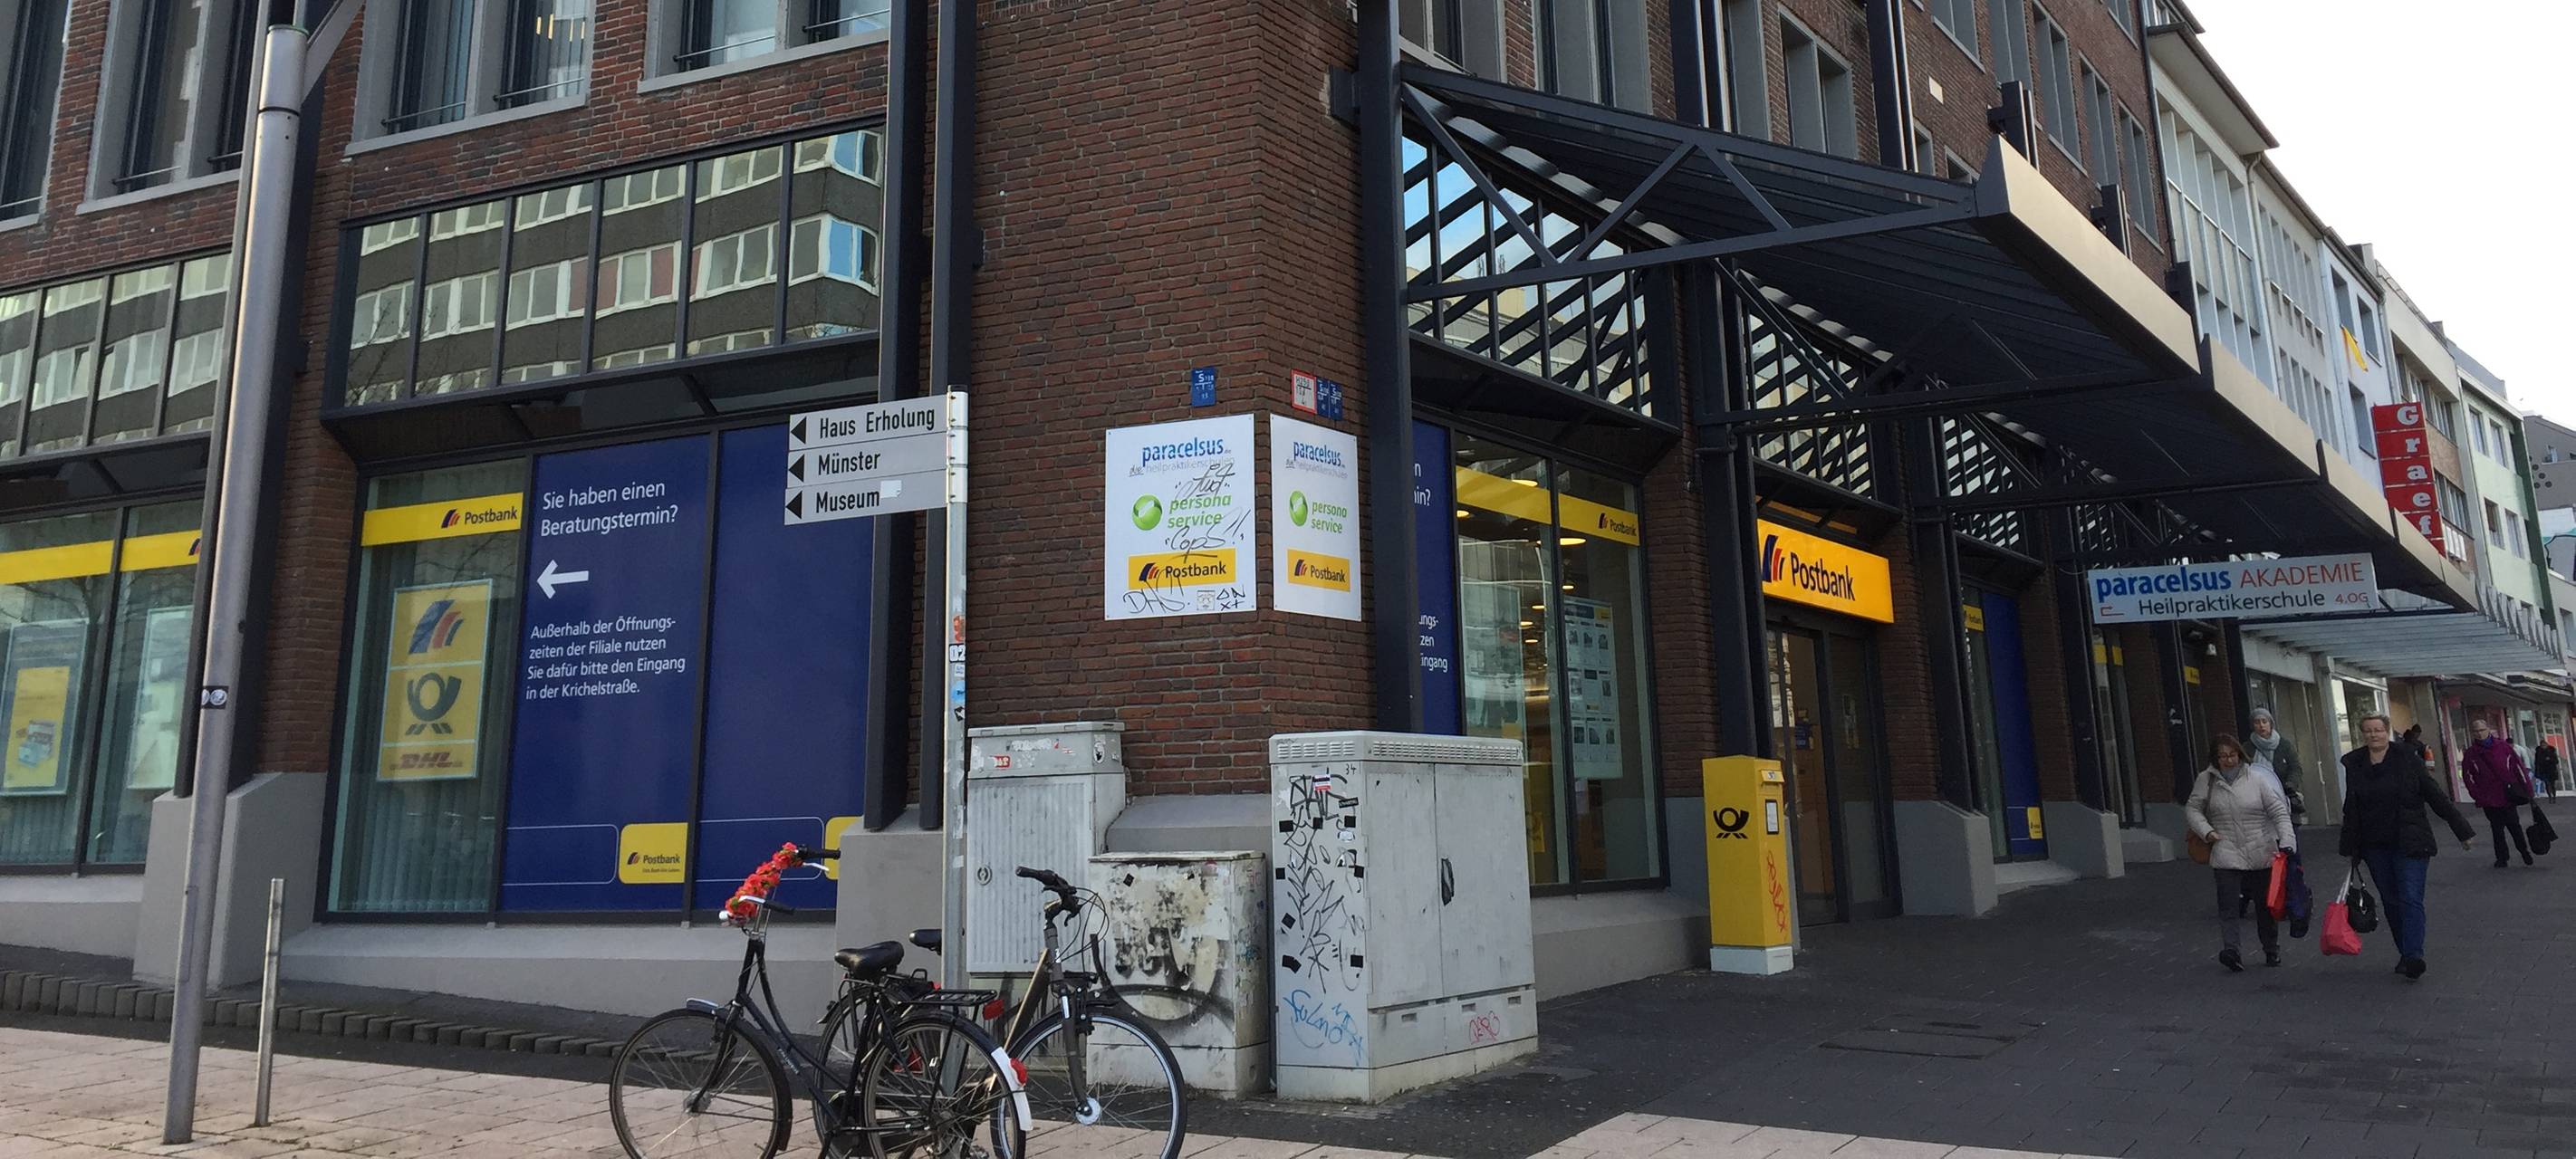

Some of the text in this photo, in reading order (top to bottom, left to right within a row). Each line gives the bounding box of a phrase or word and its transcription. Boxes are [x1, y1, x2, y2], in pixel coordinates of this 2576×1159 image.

[820, 407, 936, 439] Haus Erholung
[818, 451, 881, 476] Münster
[1142, 437, 1225, 468] paracelsus
[1293, 441, 1341, 467] paracelsus
[2397, 406, 2432, 535] Graef
[543, 481, 666, 510] Sie haben einen
[816, 491, 879, 513] Museum
[1169, 494, 1232, 514] persona
[464, 505, 518, 525] Postbank
[540, 504, 679, 537] Beratungstermin?
[1168, 511, 1223, 528] service
[1312, 518, 1342, 533] service
[1165, 560, 1227, 579] Postbank
[1310, 565, 1346, 583] Postbank
[1790, 551, 1855, 601] Postbank
[2096, 562, 2365, 603] paracelsus AKADEMIE
[2139, 589, 2325, 618] Heilpraktikerschule
[530, 616, 677, 639] Außerhalb der Öffnungs-
[529, 638, 666, 659] zeiten der Filiale nutzen
[527, 657, 686, 679] Sie dafür bitte den Eingang
[1420, 653, 1448, 673] ingang
[525, 679, 640, 700] in der Krichelstraße.
[400, 752, 452, 769] DHL
[643, 854, 681, 865] Postbank
